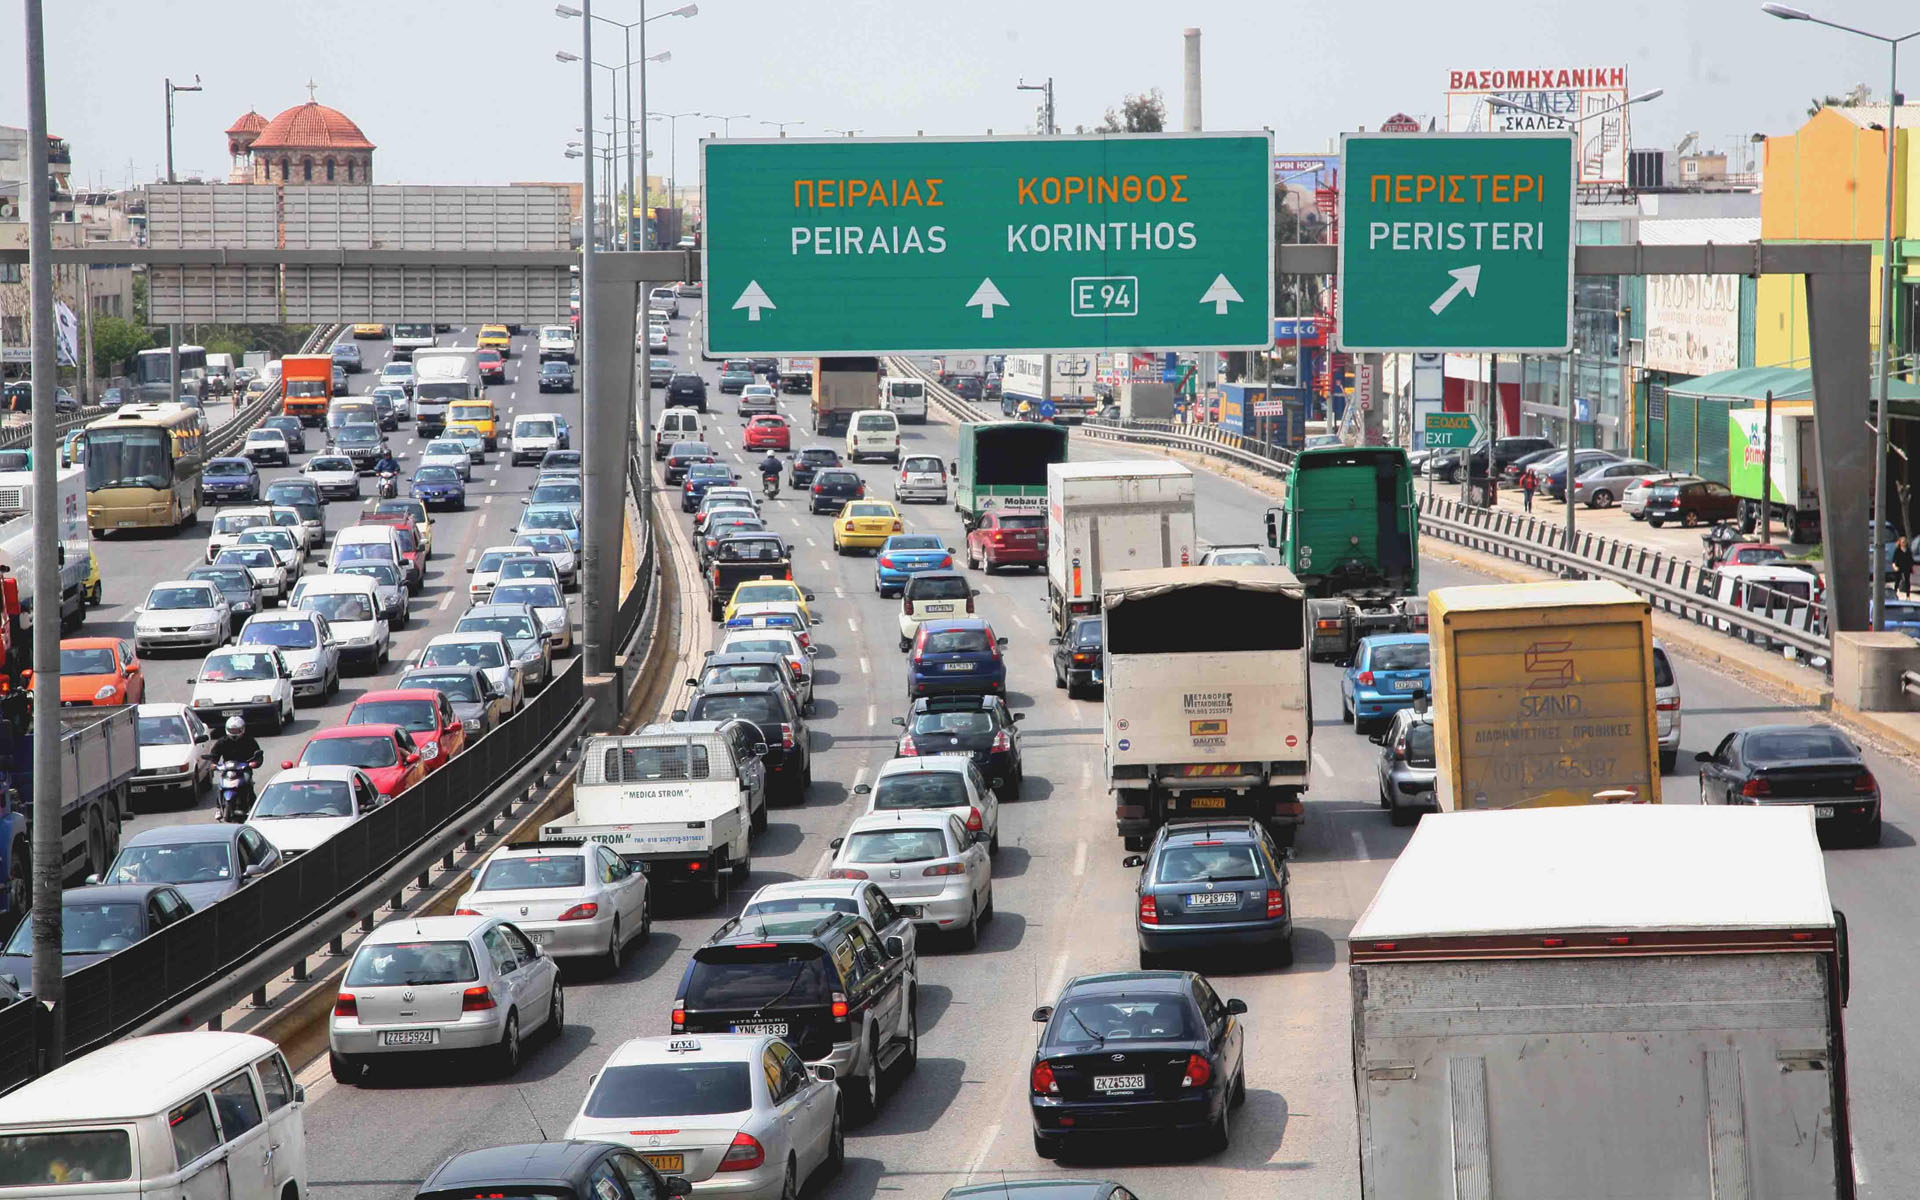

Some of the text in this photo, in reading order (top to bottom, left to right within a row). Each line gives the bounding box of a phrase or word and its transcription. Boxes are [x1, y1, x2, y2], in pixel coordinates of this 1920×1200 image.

[1449, 67, 1624, 90] ΒΑΣΟΜΗΧΑΝΙΚΗ
[1494, 90, 1578, 115] ΣΚΑΛΕΣ
[1505, 116, 1565, 131] ΣΚΑΛΕΣ
[793, 179, 944, 208] ΠΕΙΡΑΙΑΣ
[1017, 174, 1188, 205] ΚΟΡΙΝΘΟΣ
[1370, 174, 1544, 203] ΠΕΡΙΣΤΕΡΙ
[791, 226, 947, 255] PEIRAIAS
[1007, 222, 1197, 253] KORINTHOS
[1369, 222, 1544, 250] PERISTERI
[1079, 284, 1130, 309] E 94
[1650, 274, 1737, 312] TROPICAL
[1281, 325, 1316, 335] EKO
[1361, 365, 1370, 410] OUTLET
[1426, 416, 1471, 429] ΕΞΟΔΟΣ
[1426, 432, 1453, 444] EXIT
[1004, 497, 1037, 505] Mobau
[1520, 695, 1582, 717] STAND
[671, 1041, 694, 1049] TAXI
